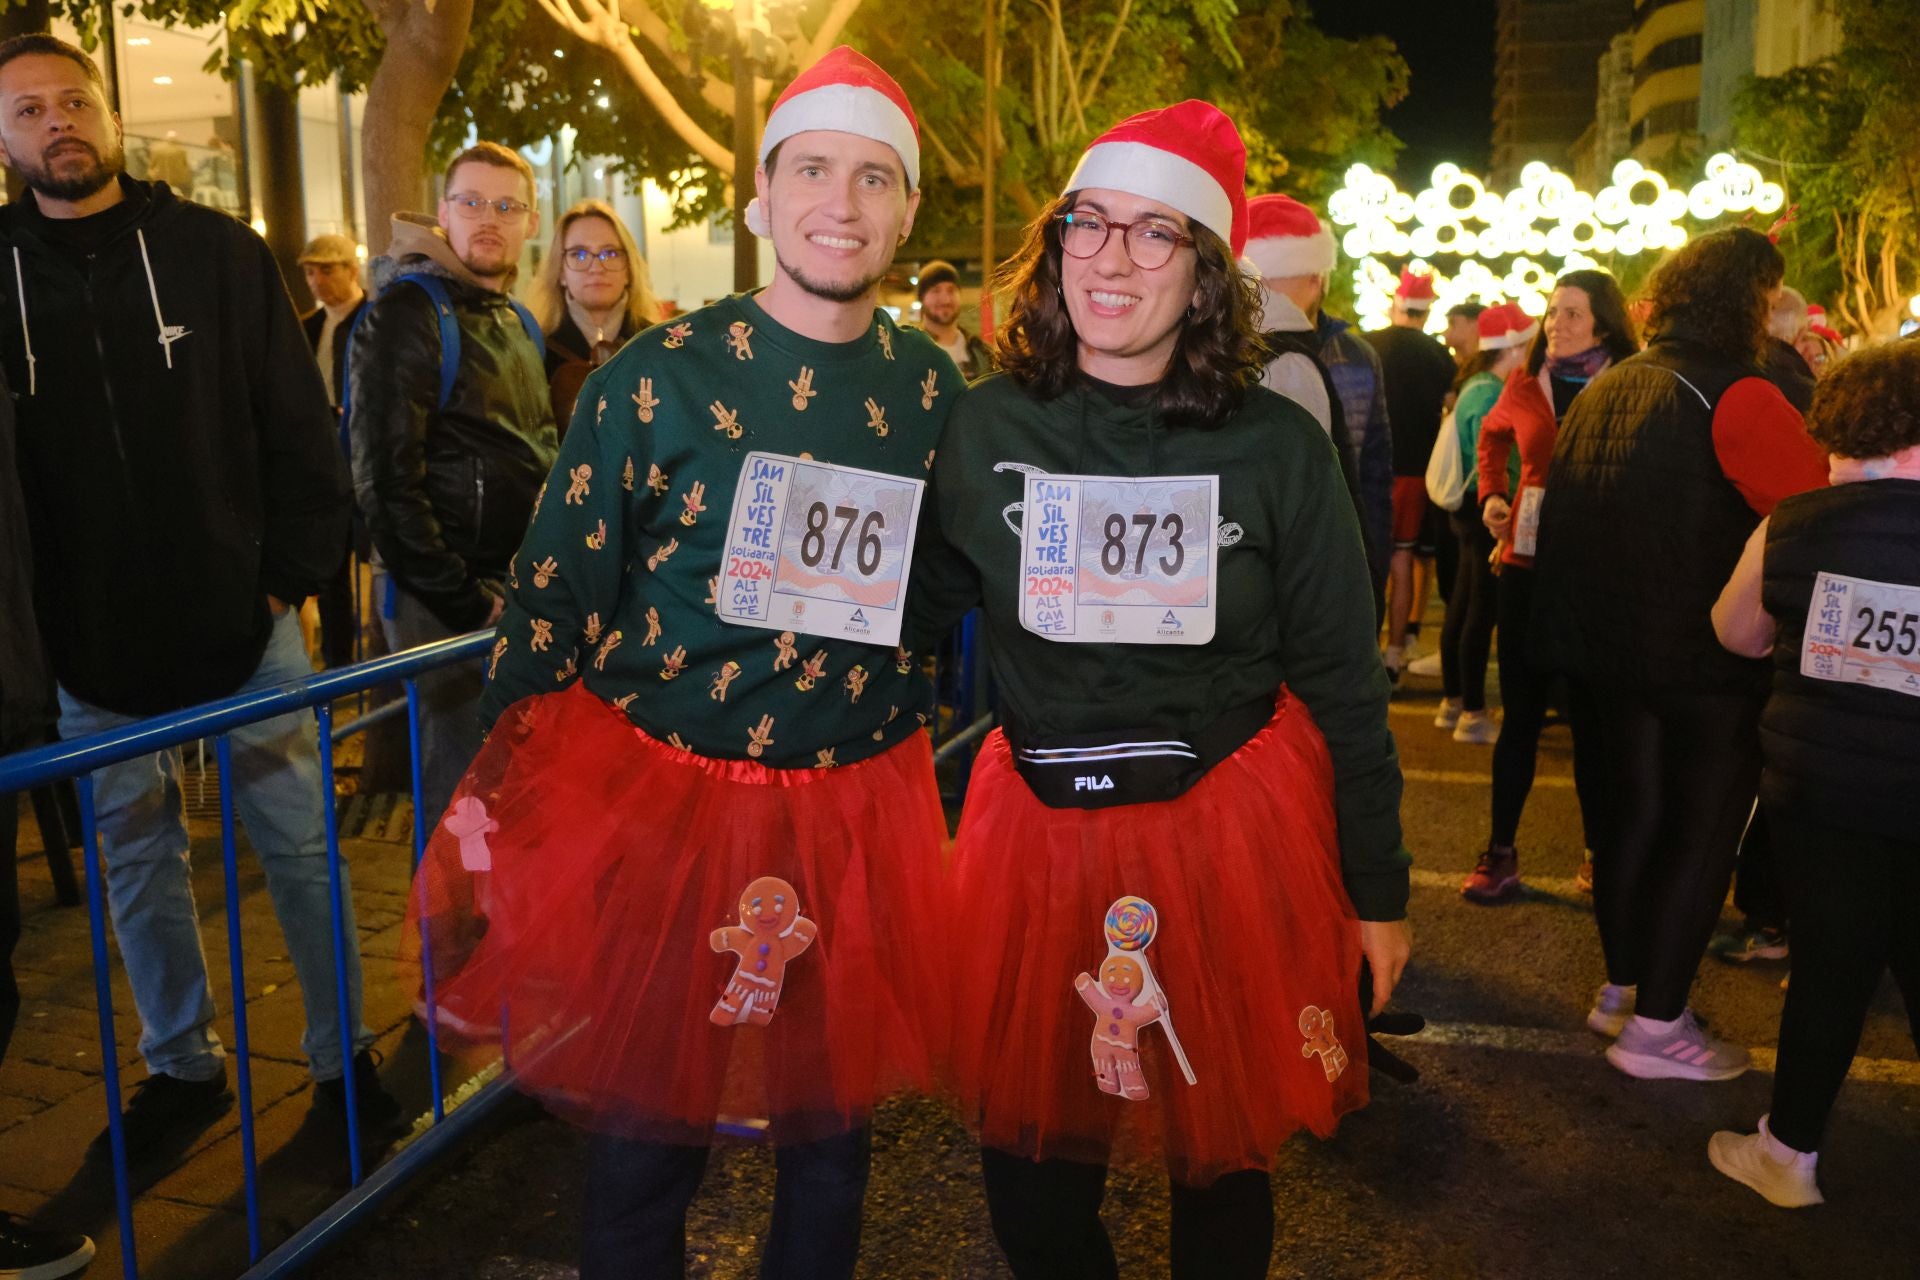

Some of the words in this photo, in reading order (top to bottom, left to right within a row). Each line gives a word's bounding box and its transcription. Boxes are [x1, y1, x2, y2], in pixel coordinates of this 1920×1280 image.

[750, 459, 784, 482] SAN
[1036, 481, 1071, 503] SAN
[747, 505, 776, 527] VES
[742, 527, 772, 548] TRE
[801, 501, 885, 576] 876
[1038, 524, 1069, 544] VES
[1101, 513, 1185, 576] 873
[1035, 545, 1068, 564] TRE
[728, 558, 773, 580] 2024
[733, 580, 758, 592] ALI
[1027, 577, 1073, 595] 2024
[1823, 579, 1847, 594] SAN
[733, 593, 758, 605] CAN
[1036, 596, 1062, 609] ALI
[733, 605, 759, 616] TE
[1037, 611, 1064, 622] CAN
[1820, 609, 1842, 624] VES
[843, 625, 871, 635] Alicante
[1037, 621, 1066, 632] TE
[1817, 623, 1840, 637] TRE
[1852, 607, 1920, 655] 255
[1808, 642, 1842, 656] 2024
[1074, 774, 1115, 791] FILA
